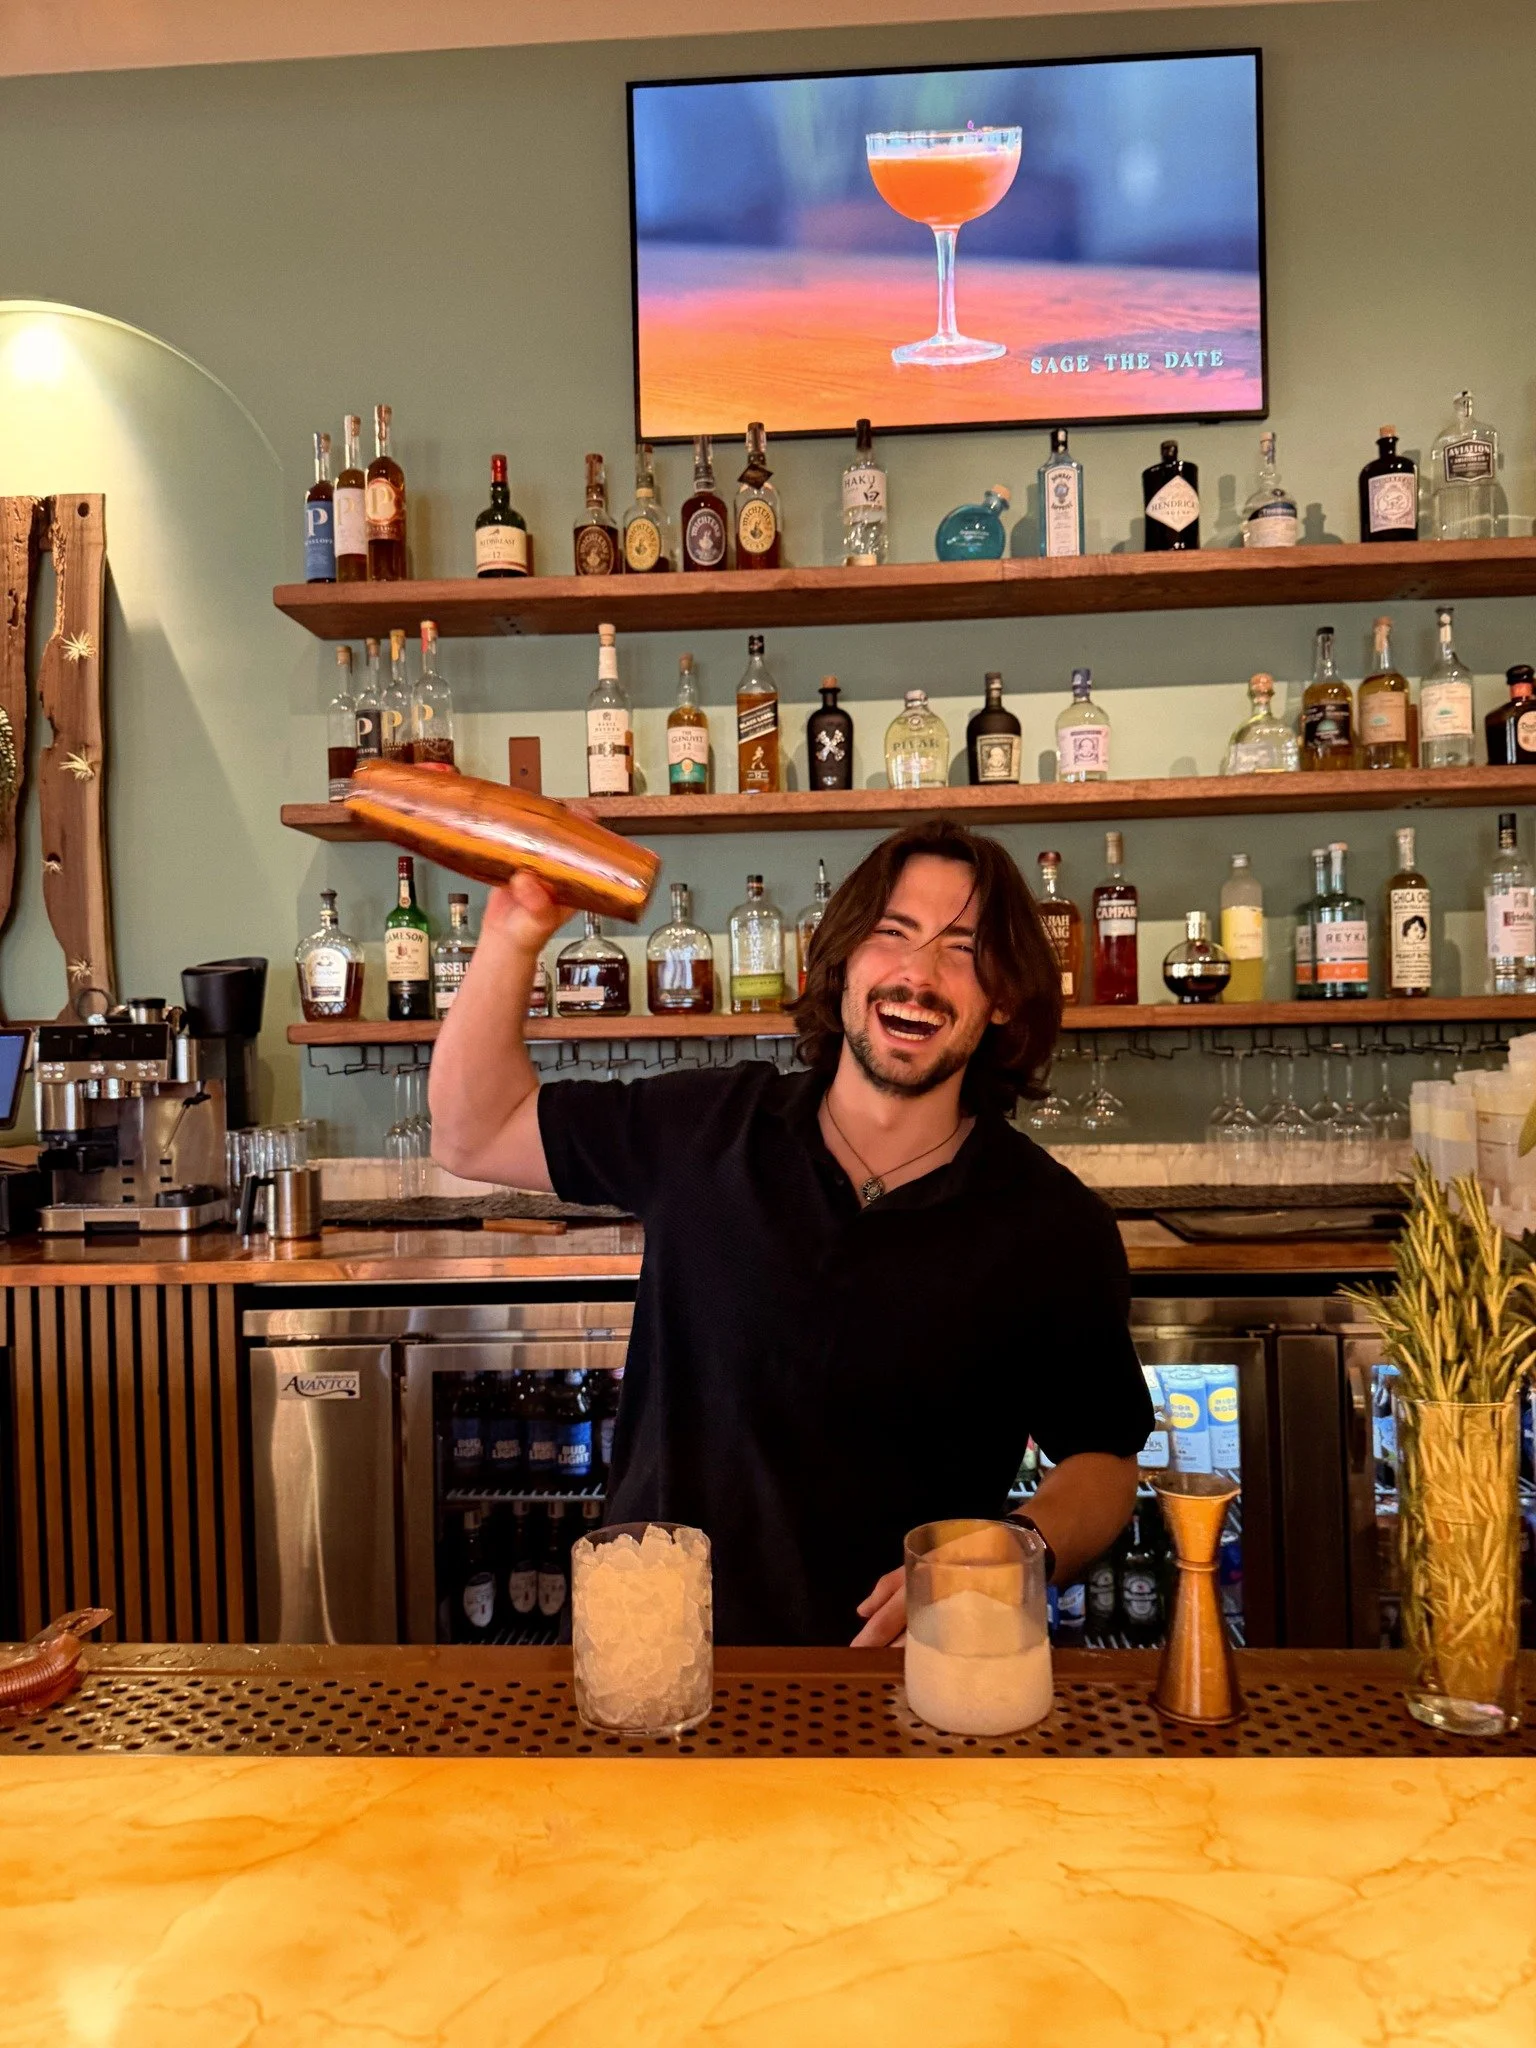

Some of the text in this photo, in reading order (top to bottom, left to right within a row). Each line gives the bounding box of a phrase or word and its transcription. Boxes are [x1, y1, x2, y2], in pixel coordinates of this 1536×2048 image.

[1030, 350, 1224, 374] SAGE THE DATE
[1448, 444, 1490, 457] AVIATION
[844, 474, 876, 489] HAKU
[306, 507, 329, 537] P
[356, 717, 373, 747] P
[382, 710, 403, 742] P
[385, 931, 425, 944] JAMESON
[281, 1375, 357, 1397] AVANTCO
[558, 1452, 590, 1464] LIGHT
[562, 1444, 587, 1454] BUD
